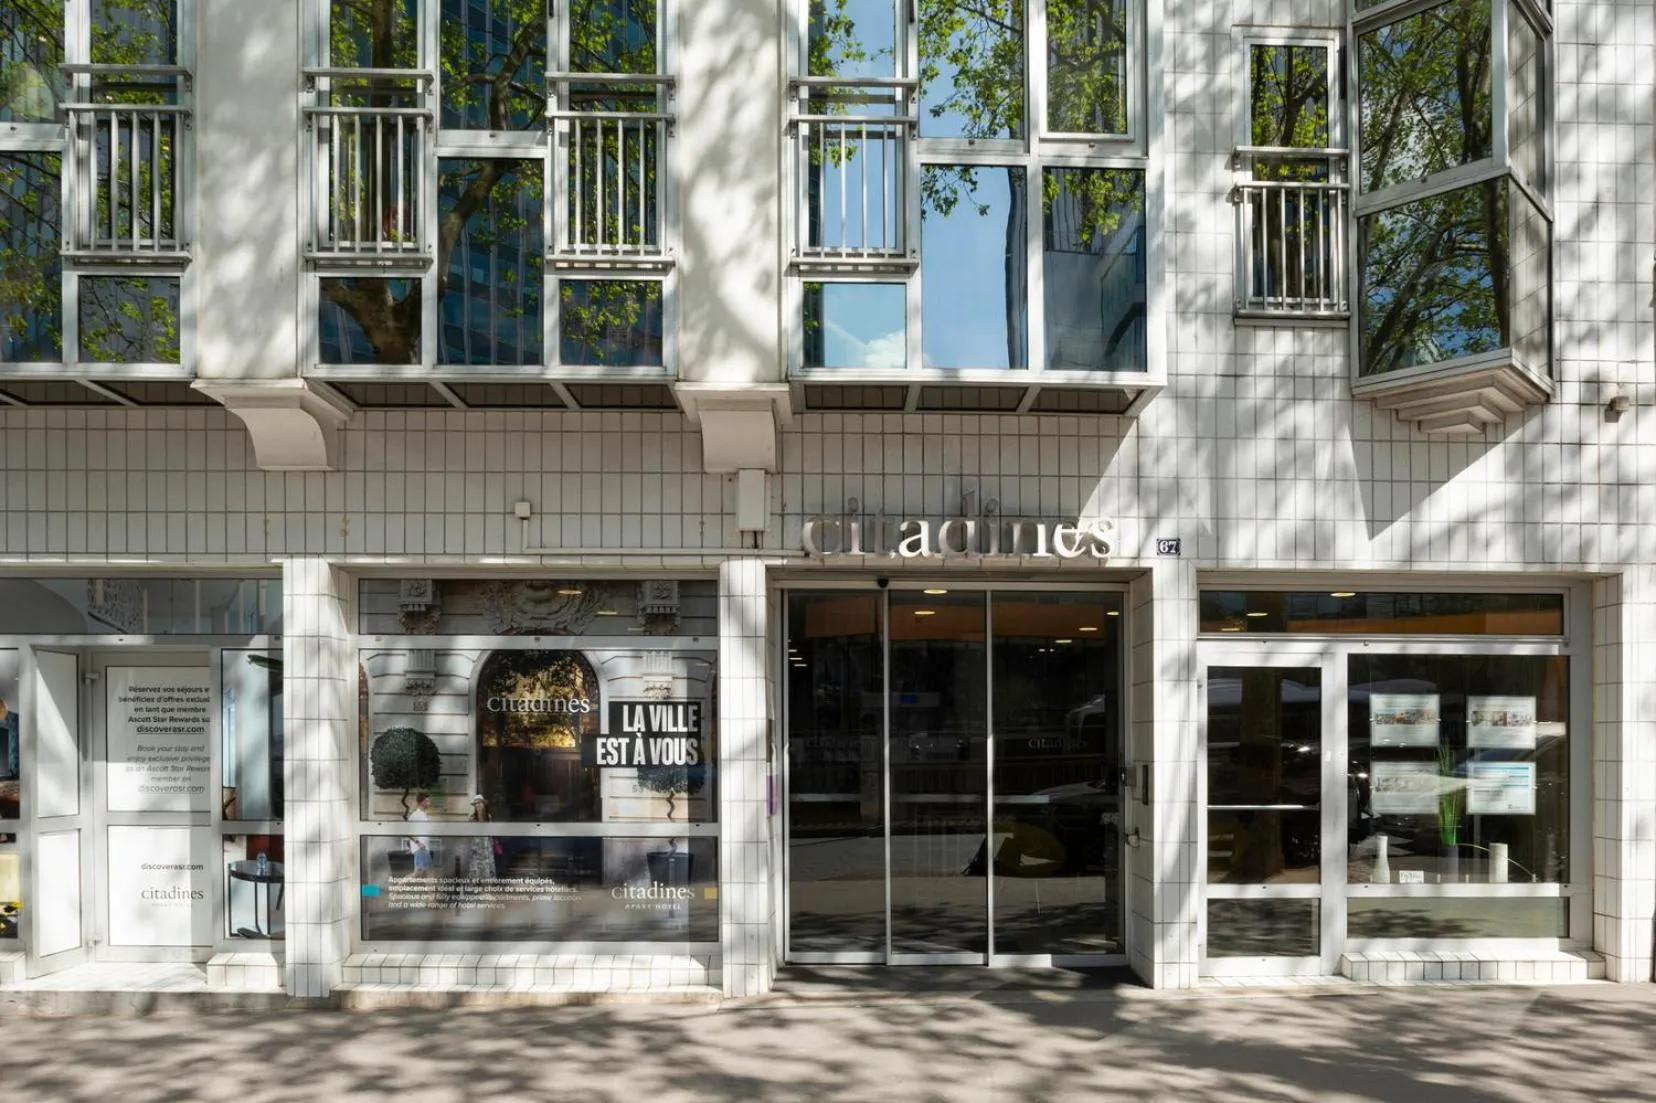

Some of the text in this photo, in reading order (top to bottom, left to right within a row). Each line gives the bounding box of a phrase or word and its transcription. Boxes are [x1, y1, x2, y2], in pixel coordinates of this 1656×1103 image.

[802, 489, 1117, 559] citadines
[1159, 540, 1177, 553] 67
[176, 686, 203, 695] séjours
[486, 696, 591, 714] citadines
[152, 715, 168, 723] Star
[169, 715, 200, 723] Rewards
[622, 703, 699, 733] LA VILLE
[136, 725, 205, 734] discoverasr.com
[596, 732, 699, 766] EST À VOUS
[140, 862, 204, 872] discoverasr.com
[140, 885, 204, 901] citadines
[464, 885, 484, 894] large
[484, 885, 503, 893] choix
[504, 885, 514, 893] de
[611, 880, 696, 900] citadines
